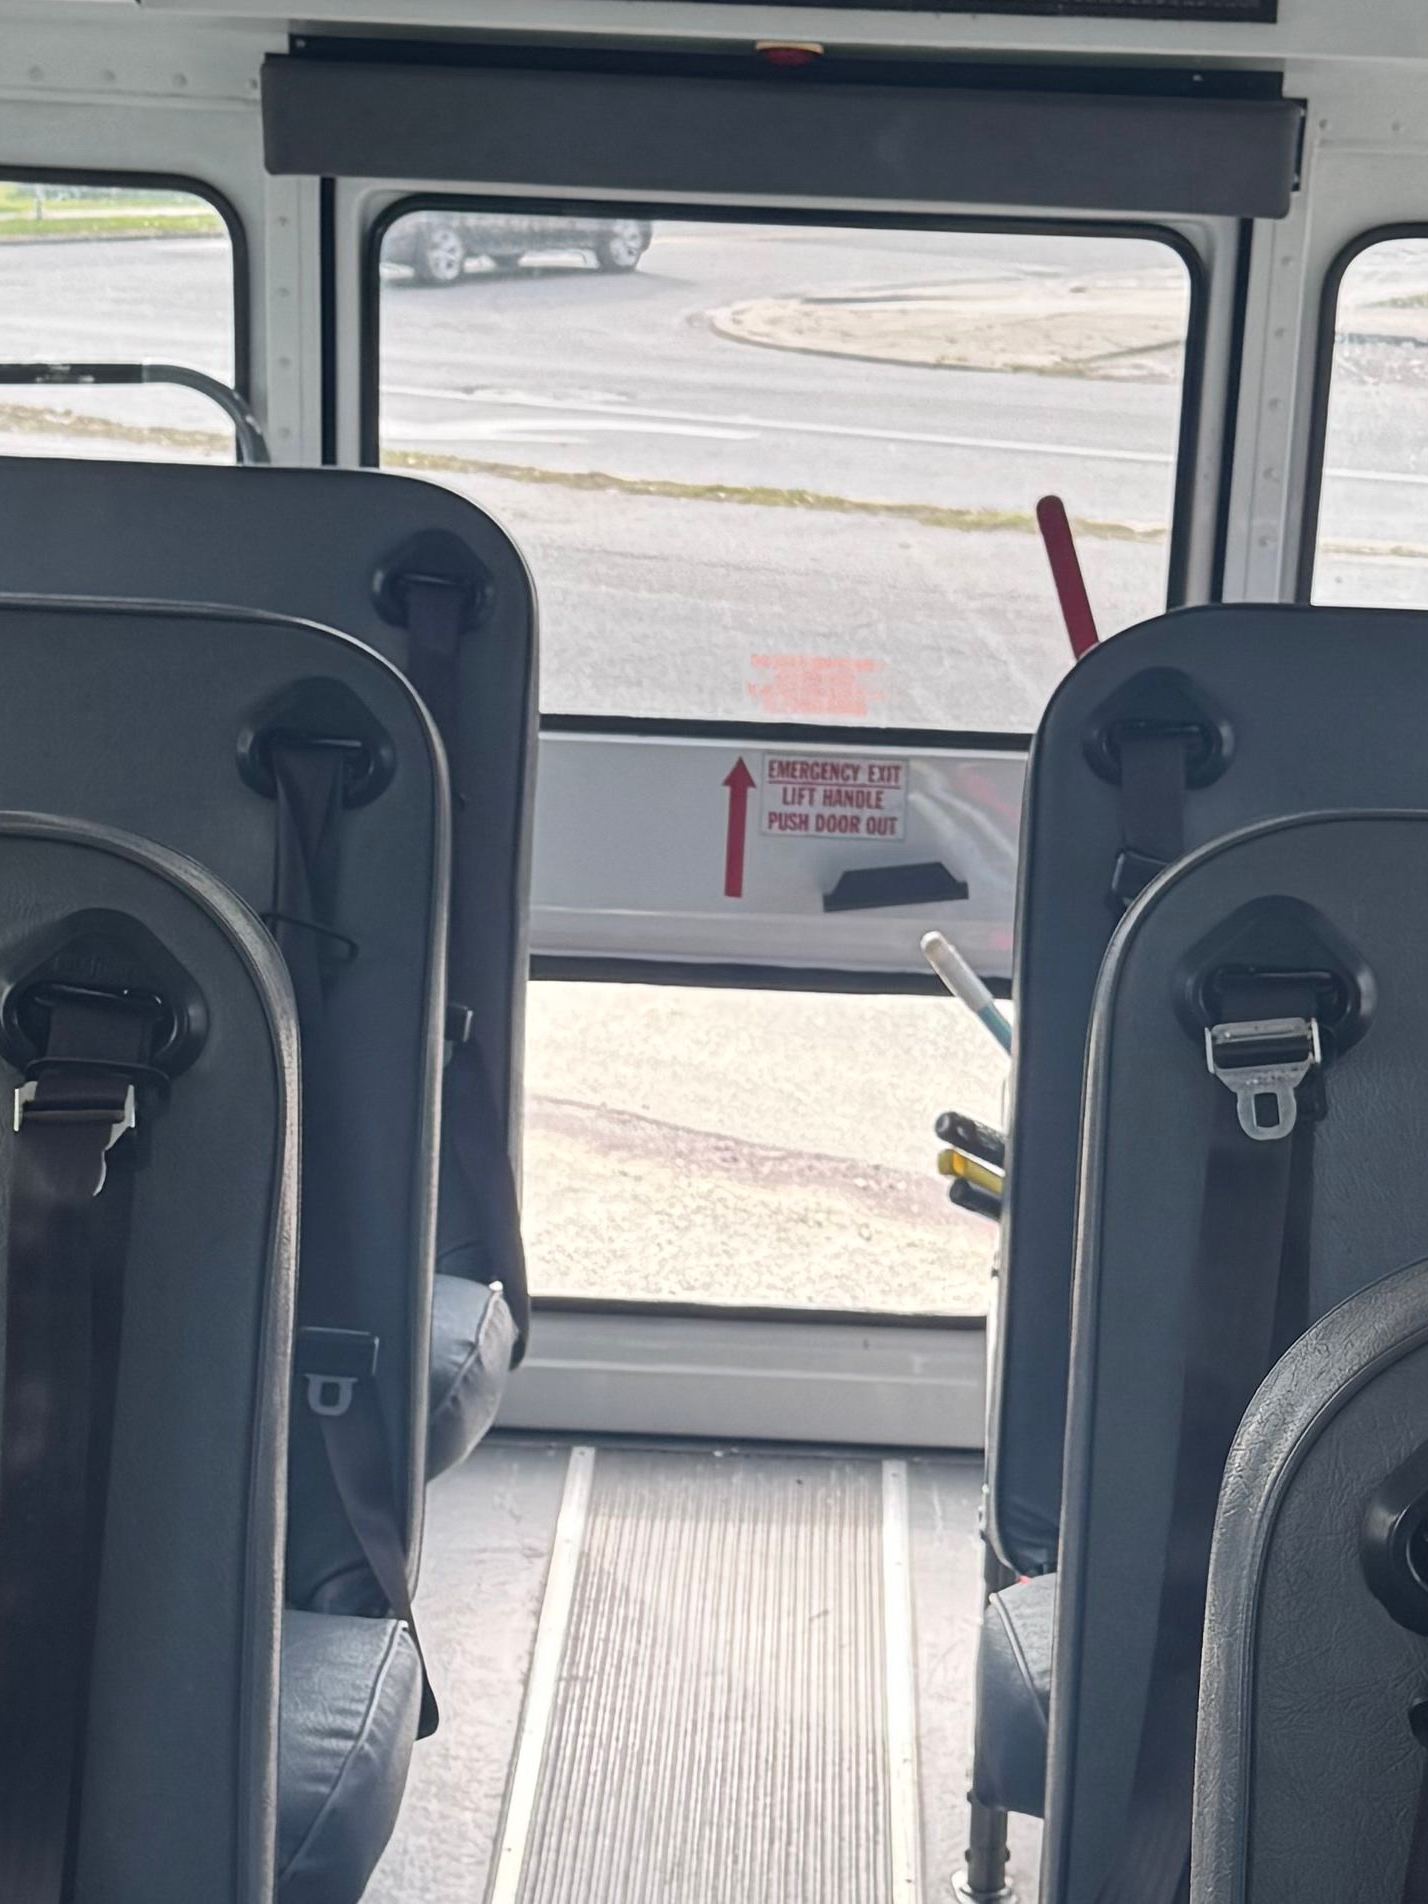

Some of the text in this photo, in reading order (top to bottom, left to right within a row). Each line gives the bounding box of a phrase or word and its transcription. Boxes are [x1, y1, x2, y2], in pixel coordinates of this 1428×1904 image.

[768, 759, 902, 784] EMERGENCY EXIT
[782, 786, 884, 810] LIFT HANDLE
[768, 811, 898, 835] PUSH DOOR OUT
